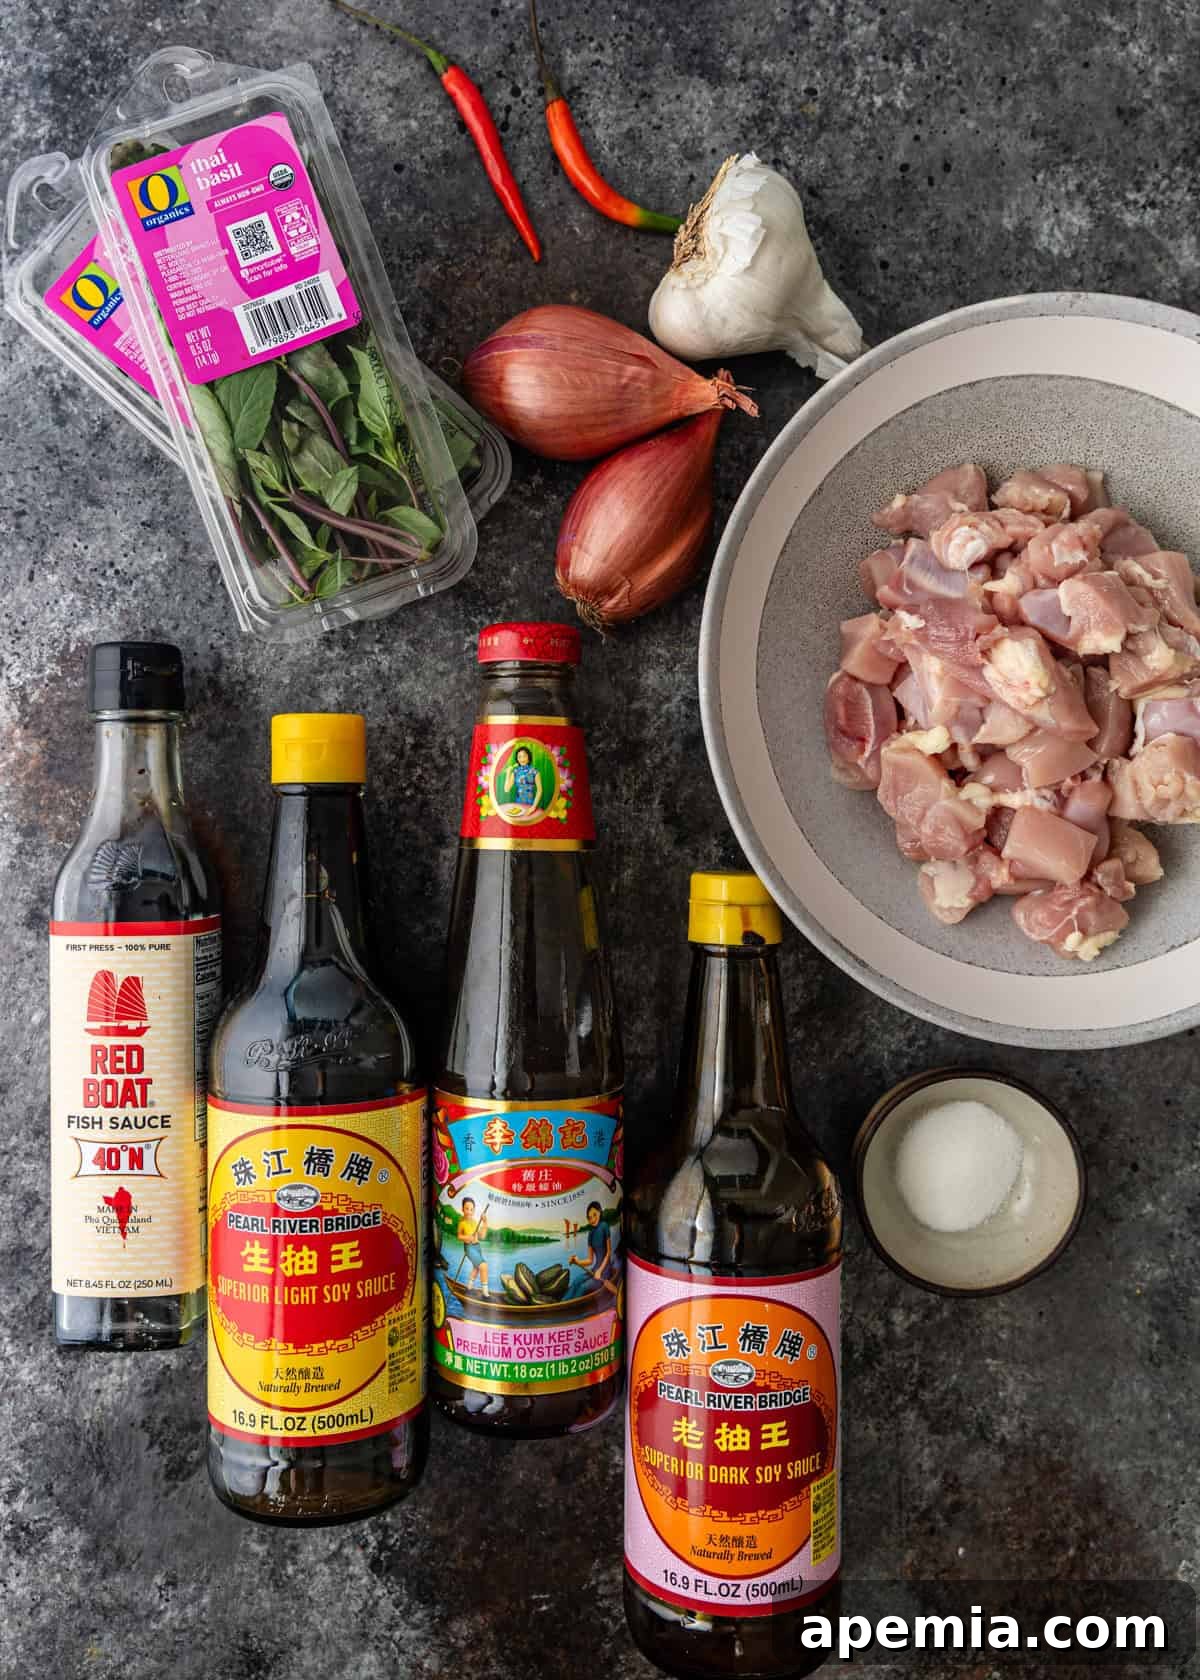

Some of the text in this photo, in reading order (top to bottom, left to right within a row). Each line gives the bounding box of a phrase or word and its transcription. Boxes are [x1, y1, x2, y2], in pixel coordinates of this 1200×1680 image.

[189, 148, 228, 175] thai
[195, 162, 243, 190] basil
[145, 206, 191, 227] organics
[189, 338, 213, 356] 0.5 OZ
[268, 331, 296, 347] 79893
[299, 319, 327, 334] 16451
[65, 943, 171, 952] FIRST PRESS 100% PURE
[90, 1044, 145, 1075] RED
[82, 1078, 153, 1109] BOAT
[67, 1114, 172, 1130] FISH SAUCE
[482, 1117, 591, 1155] 李錦記
[231, 1145, 374, 1187] 珠江橋牌
[228, 1211, 383, 1234] PEARL RIVER BRIDGE
[240, 1240, 363, 1277] 生抽王
[66, 1278, 173, 1290] NET 8.45 FL OZ (250 ML)
[217, 1272, 397, 1305] SUPERIOR LIGHT SOY SAUCE
[456, 1338, 512, 1359] PREMIUM
[516, 1343, 570, 1360] OYSTER
[574, 1331, 609, 1354] SAUCE
[484, 1327, 585, 1346] LEE KUM KEE'S
[662, 1322, 806, 1364] 珠江橋牌
[466, 1359, 489, 1375] NET
[488, 1363, 511, 1378] WT.
[514, 1365, 527, 1378] 18
[529, 1367, 543, 1378] oz
[557, 1361, 569, 1376] lb
[570, 1359, 577, 1373] 2
[578, 1355, 594, 1371] oz)
[594, 1350, 609, 1366] 510
[258, 1378, 341, 1397] Naturally Brewed
[658, 1382, 811, 1411] PEARL RIVER BRIDGE
[232, 1407, 374, 1433] 16.9 FL.OZ (500mL)
[672, 1415, 790, 1452] 老抽王
[643, 1445, 821, 1485] SUPERIOR DARK SOY SAUCE
[690, 1544, 773, 1564] Naturally Brewed
[664, 1569, 803, 1602] 16.9 FL.OZ (500mL)
